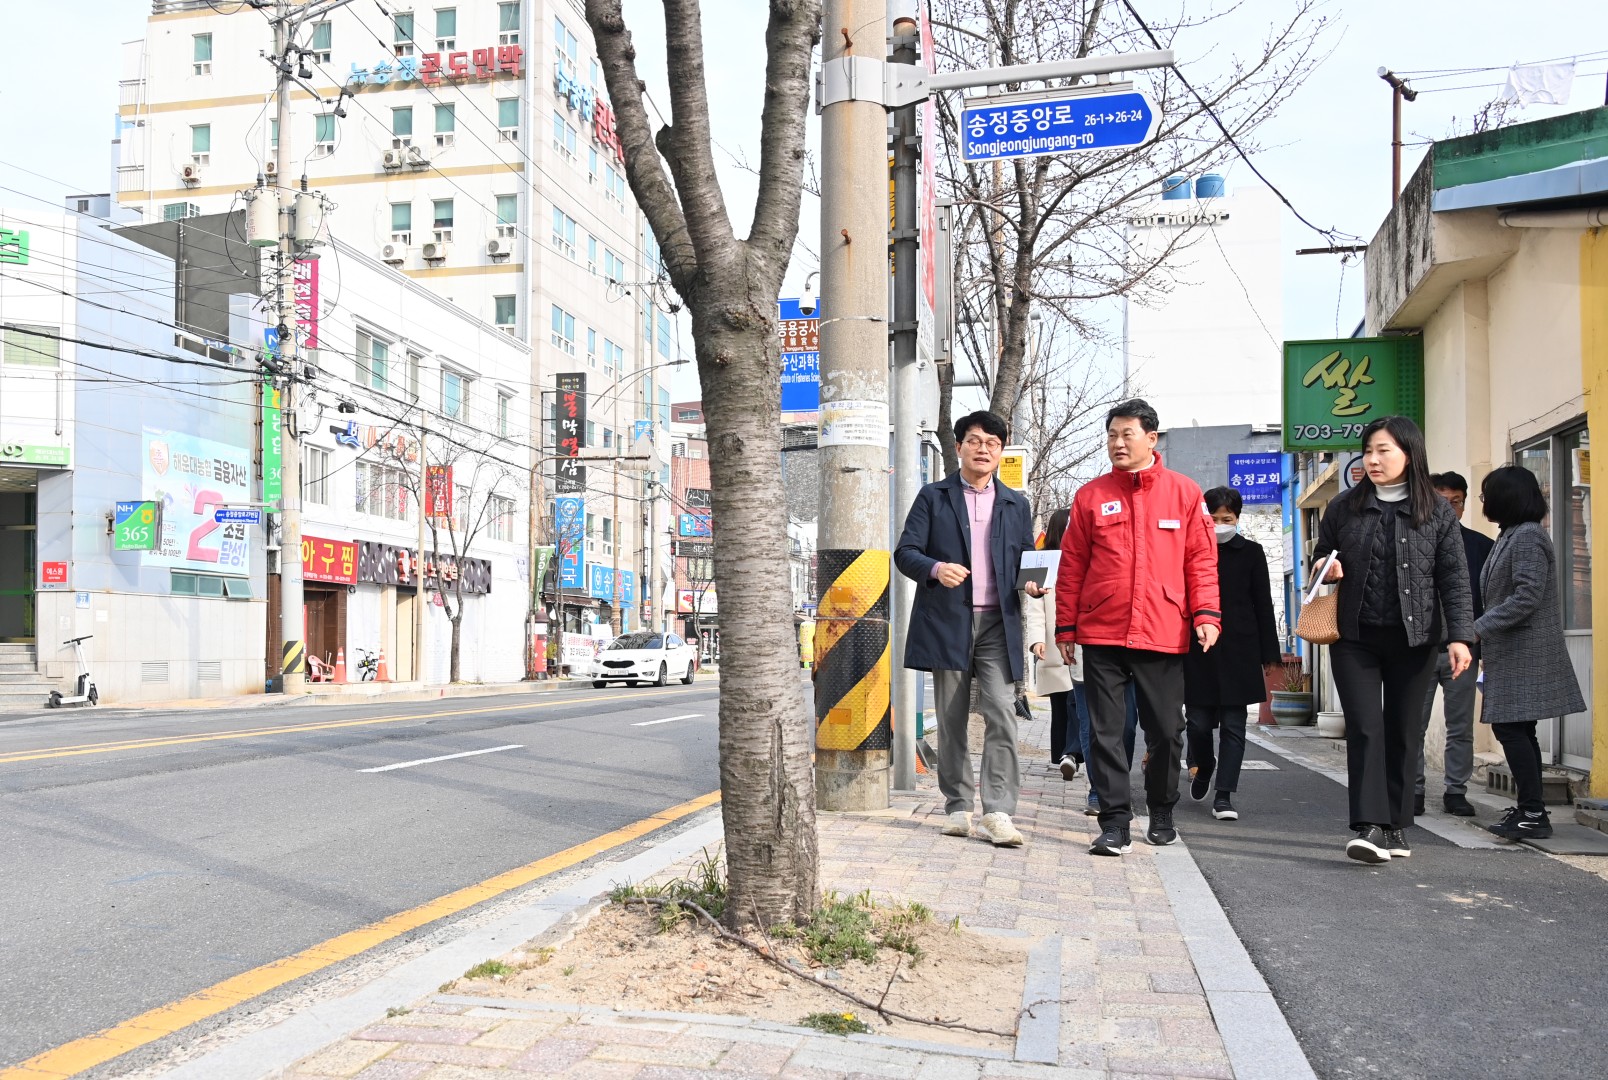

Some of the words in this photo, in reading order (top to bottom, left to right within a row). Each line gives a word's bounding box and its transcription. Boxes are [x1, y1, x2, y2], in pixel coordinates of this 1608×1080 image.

[967, 105, 1074, 138] 송정중앙로
[968, 132, 1094, 156] Songjeongjungang-ro
[173, 452, 212, 477] 해운대농협
[213, 458, 247, 487] 금융자산
[1230, 472, 1281, 486] 송정교회
[121, 526, 149, 542] 365
[186, 490, 223, 563] 2
[302, 540, 354, 576] 아구찜
